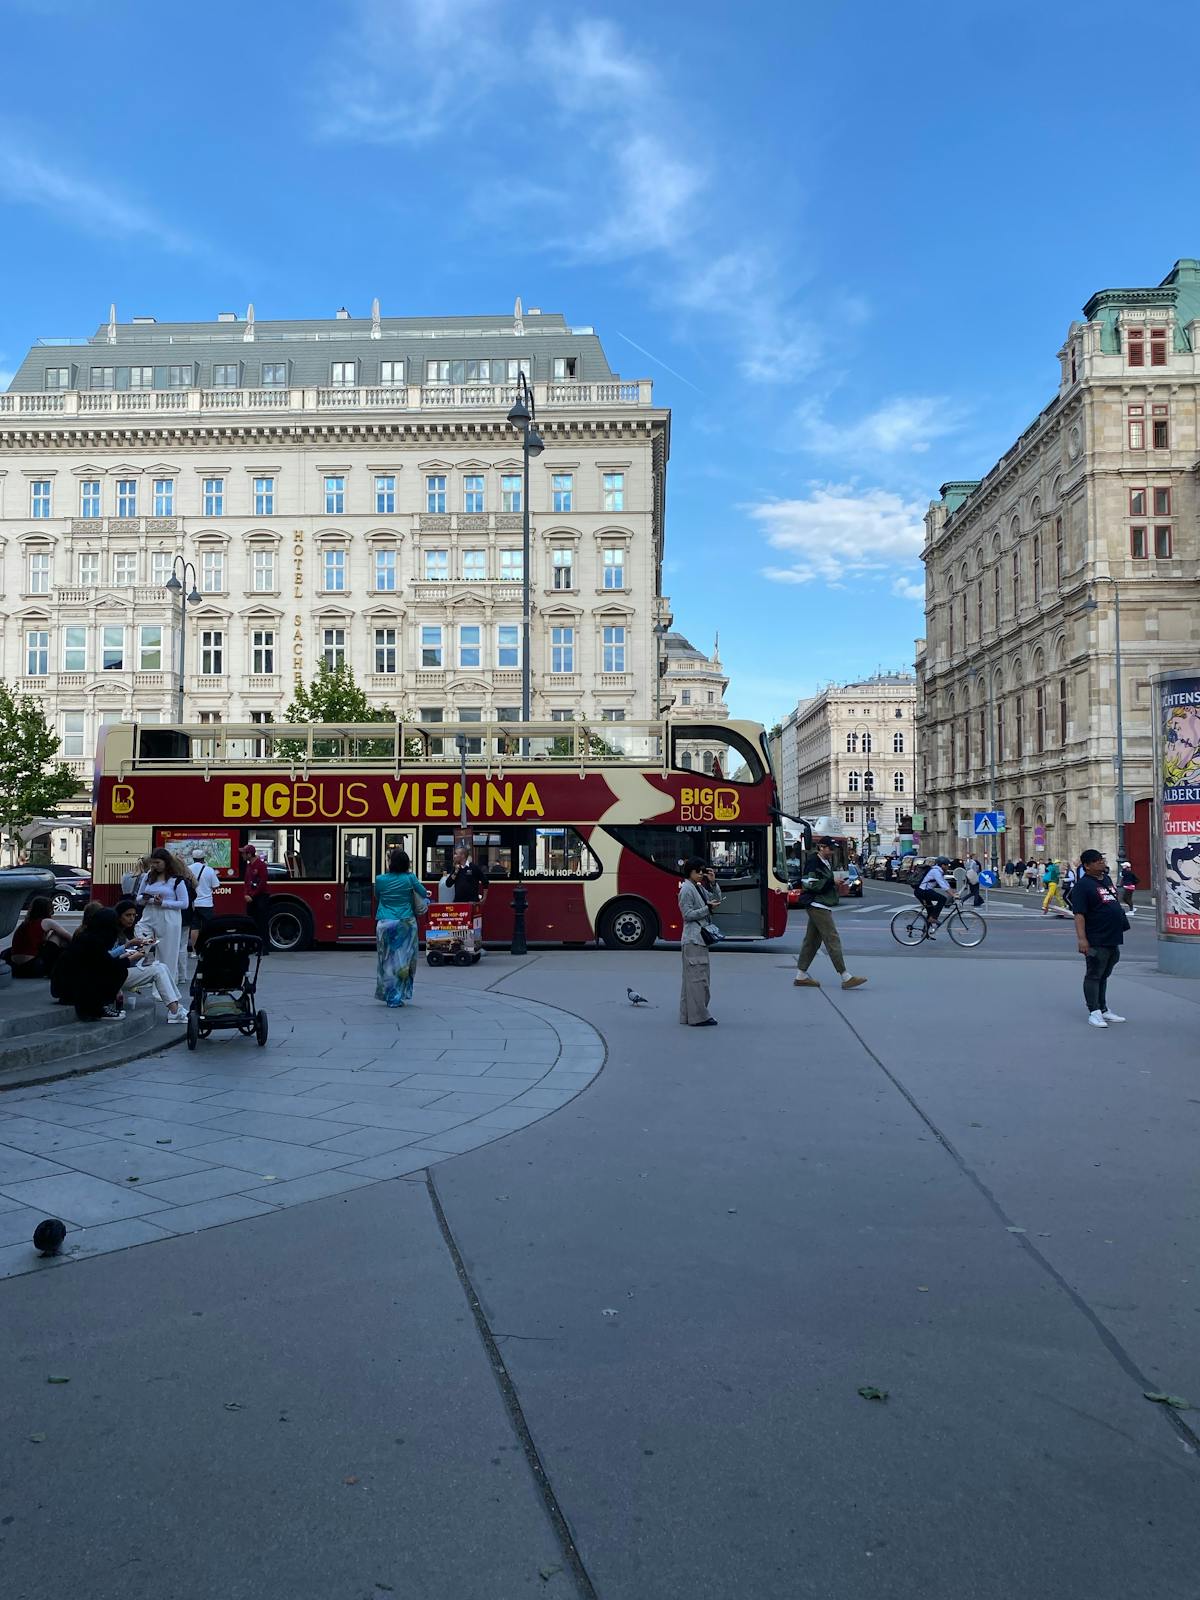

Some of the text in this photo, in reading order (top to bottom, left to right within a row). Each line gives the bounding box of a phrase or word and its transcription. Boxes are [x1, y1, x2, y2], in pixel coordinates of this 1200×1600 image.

[293, 530, 304, 696] HOTEL SACHE
[382, 782, 545, 817] VIENNA
[680, 788, 714, 805] BIG
[680, 805, 714, 821] BUS
[523, 869, 592, 877] HOP-ON HOP-OFF
[213, 887, 232, 895] .COM
